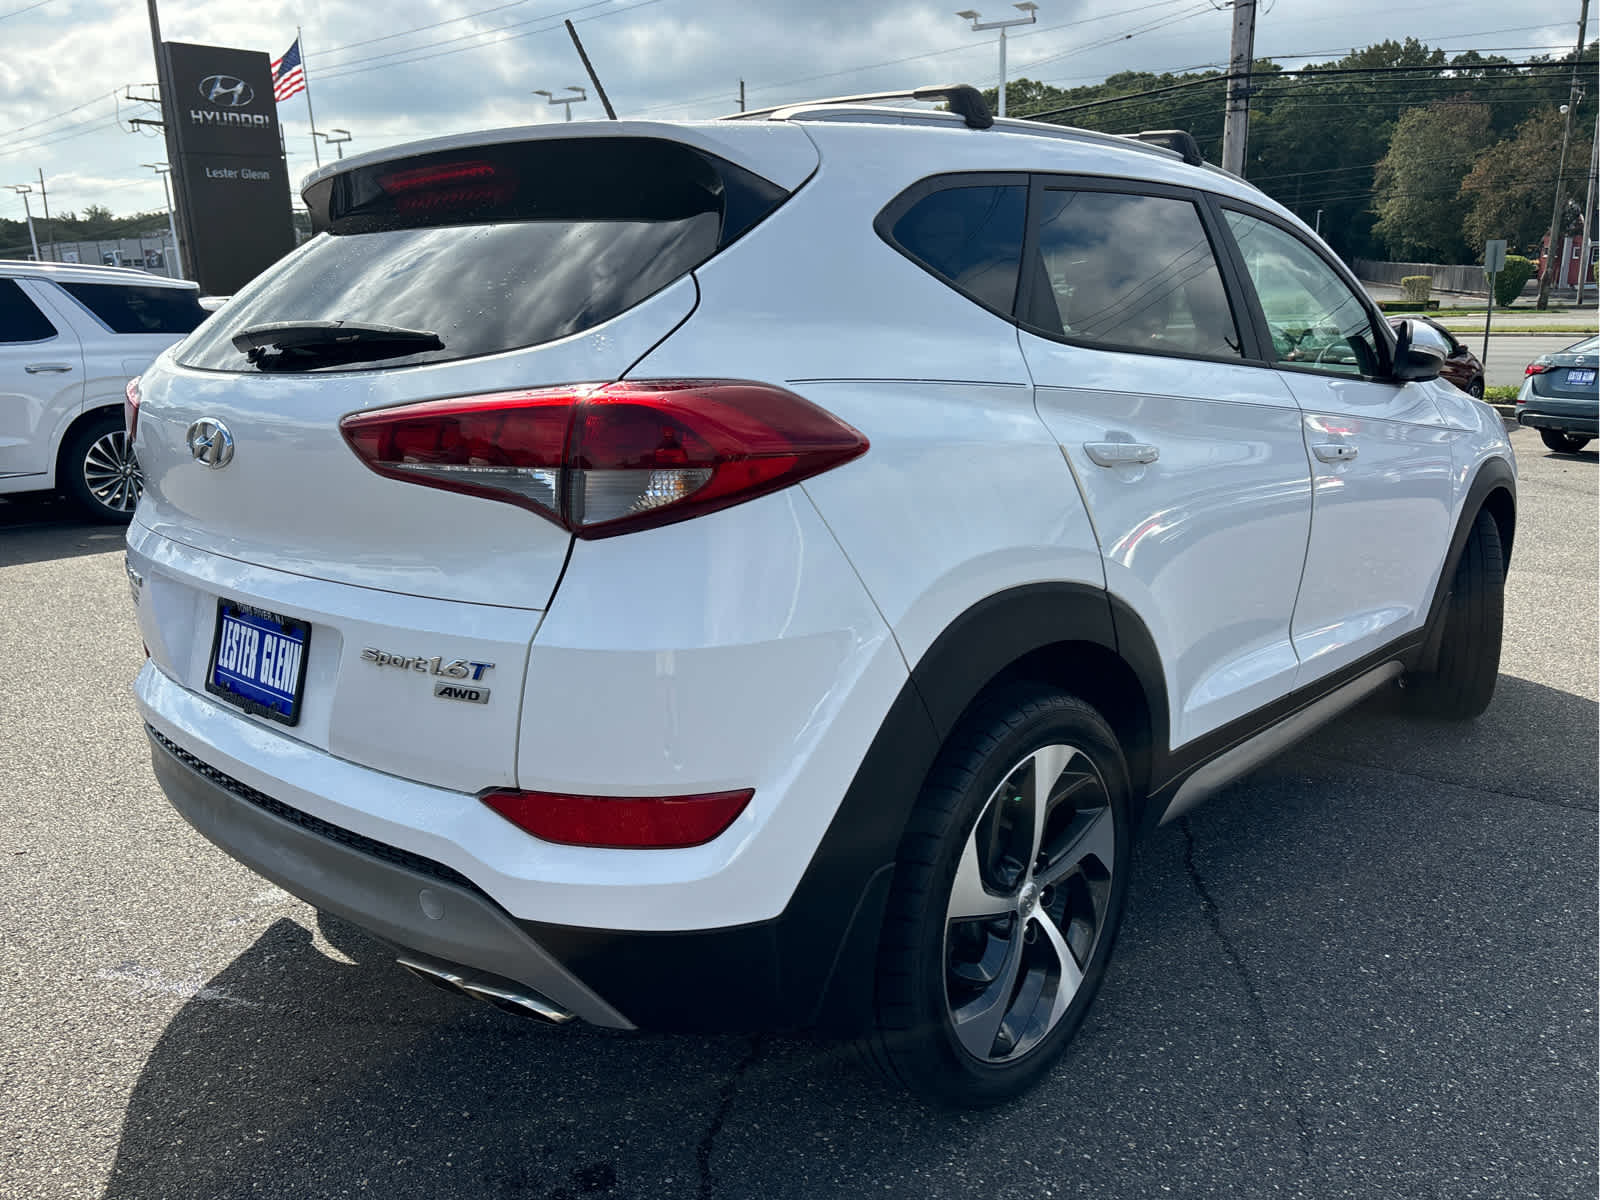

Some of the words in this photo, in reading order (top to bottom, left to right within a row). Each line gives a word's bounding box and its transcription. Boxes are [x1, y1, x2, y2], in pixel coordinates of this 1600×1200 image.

[190, 110, 269, 124] HYUNDAI
[205, 167, 238, 179] Lester
[241, 168, 270, 180] Glenn
[218, 619, 259, 680] LESTER
[259, 634, 303, 696] GLENN
[438, 686, 481, 701] AWD
